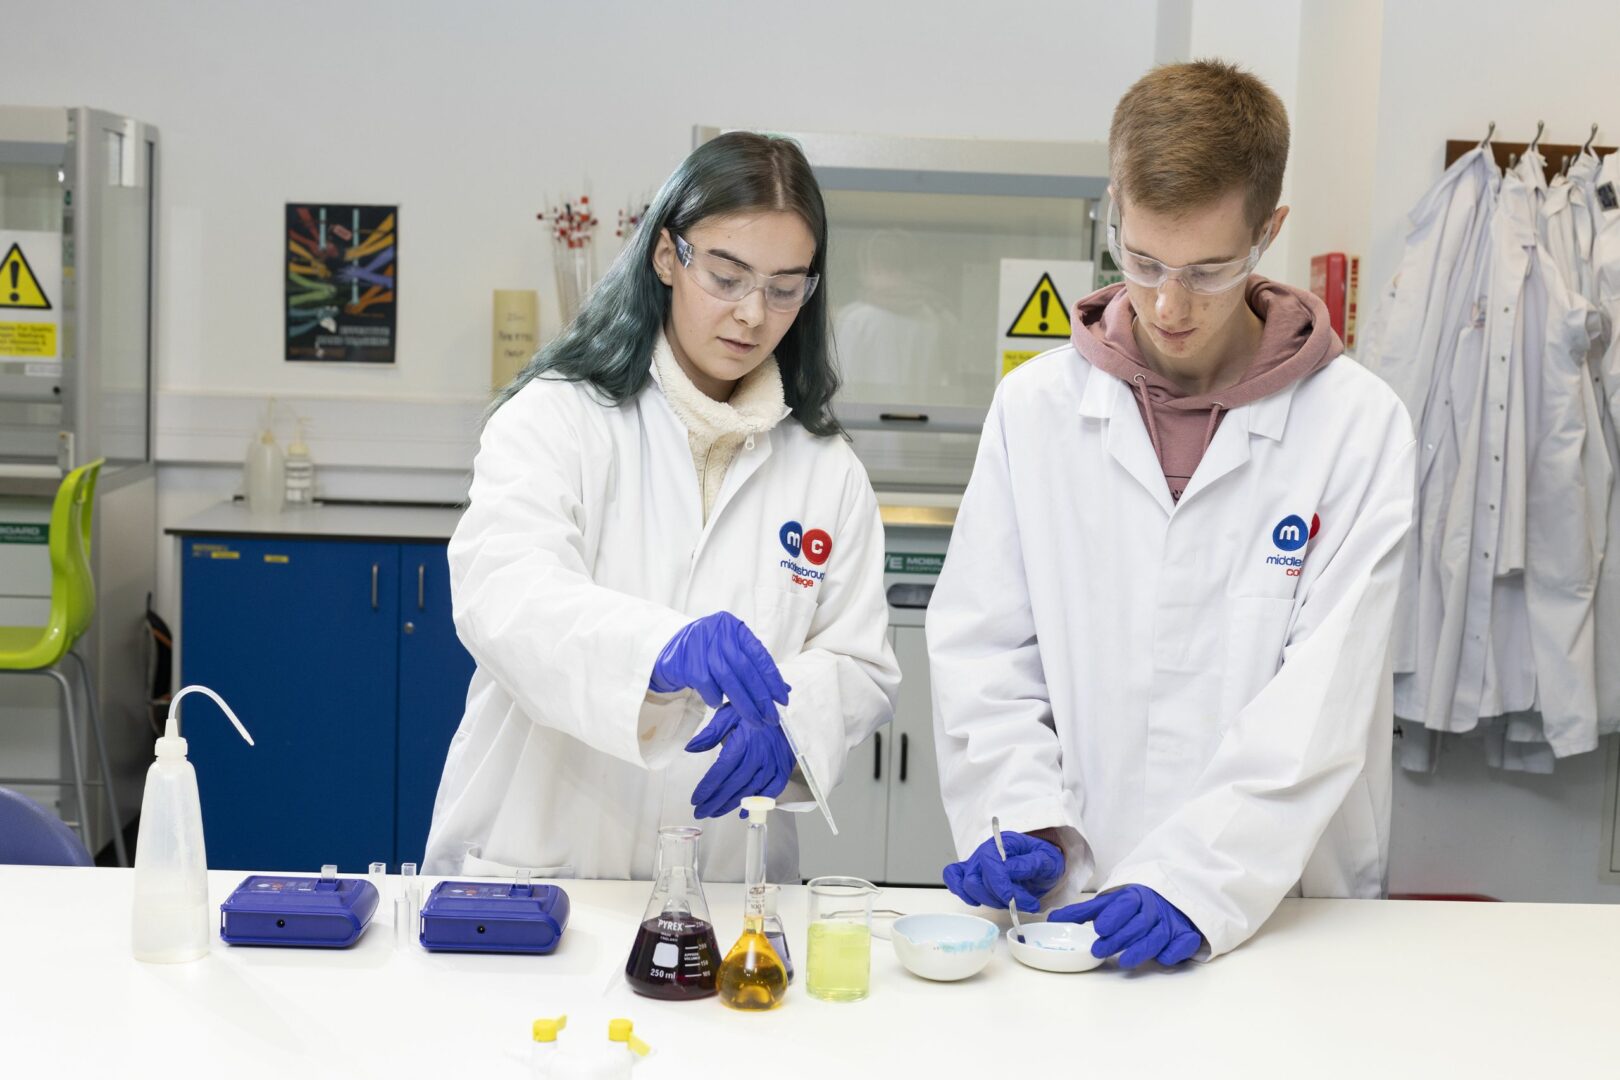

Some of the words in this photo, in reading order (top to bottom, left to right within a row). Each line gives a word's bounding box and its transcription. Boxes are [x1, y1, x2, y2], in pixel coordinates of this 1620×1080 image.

[1278, 525, 1300, 542] m
[1266, 554, 1304, 567] middle
[657, 918, 683, 932] PYREX
[650, 968, 665, 978] 250
[665, 971, 676, 979] ml
